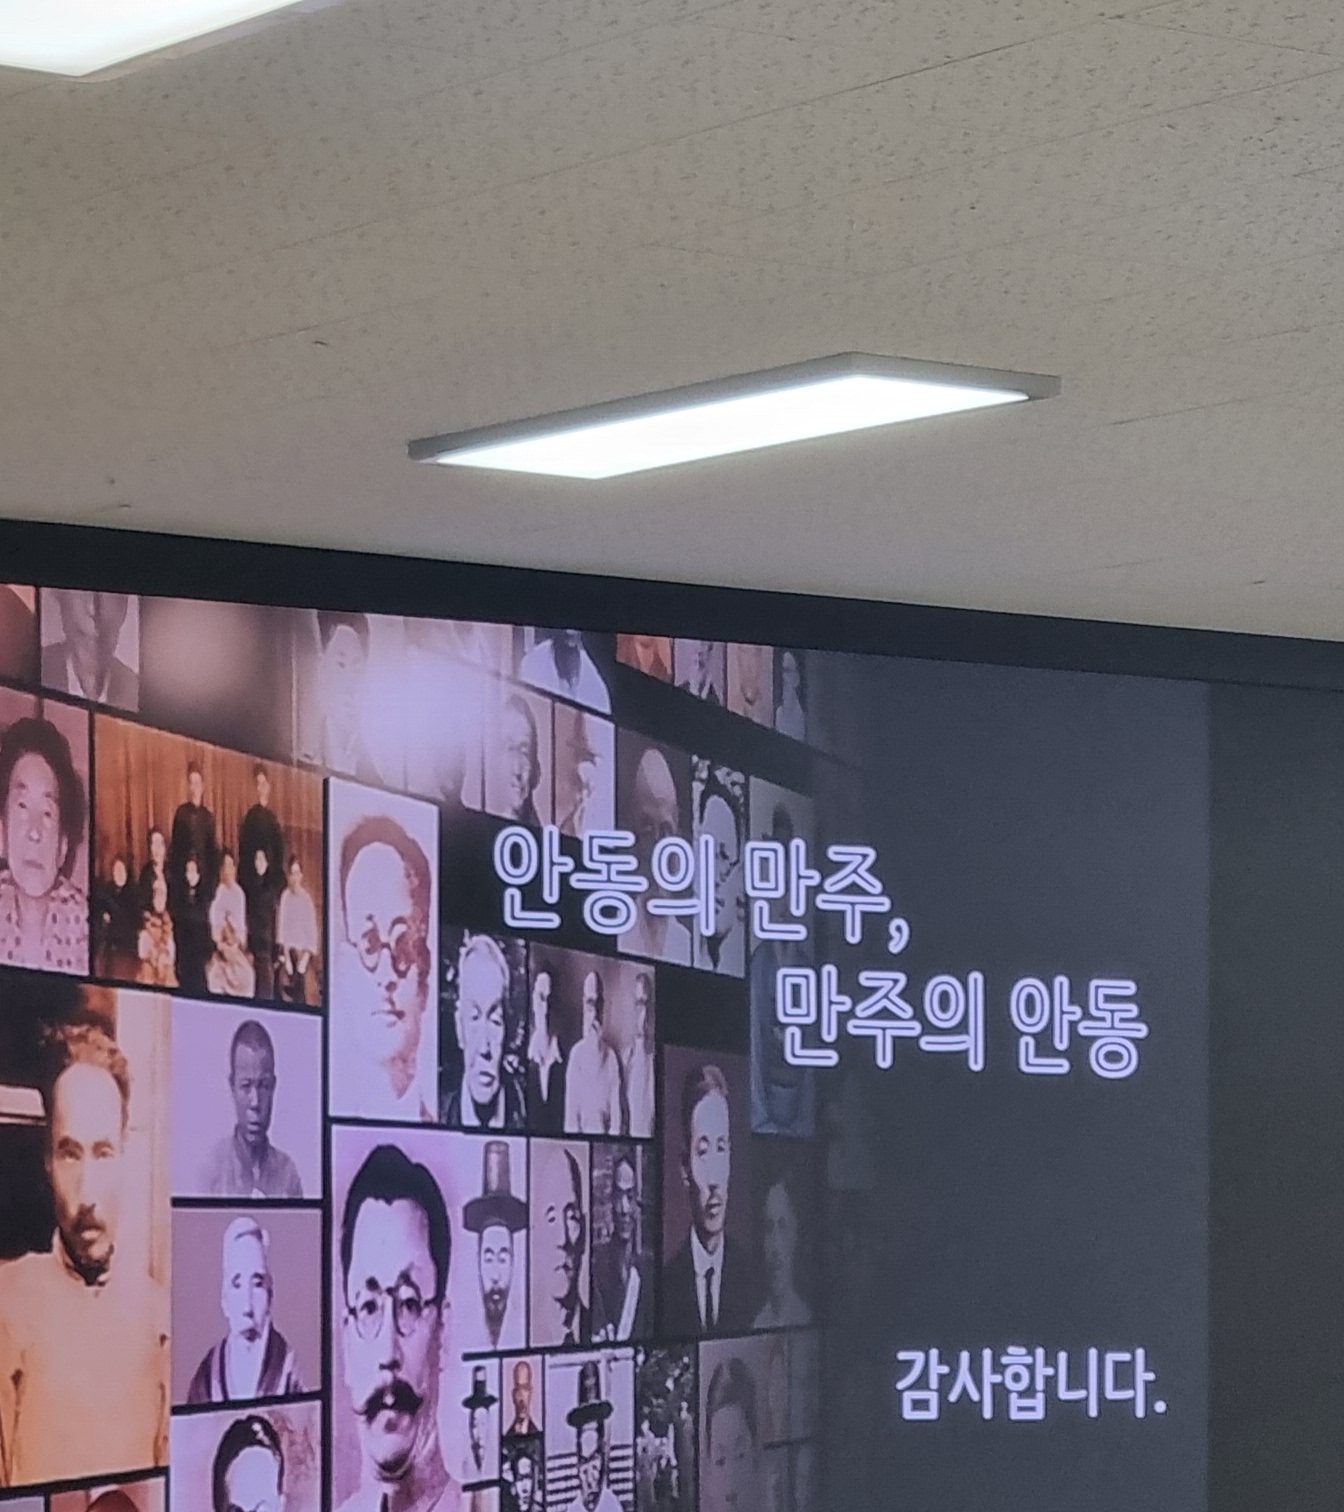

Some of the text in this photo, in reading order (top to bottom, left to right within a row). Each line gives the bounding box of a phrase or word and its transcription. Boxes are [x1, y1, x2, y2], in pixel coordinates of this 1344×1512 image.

[494, 824, 911, 953] 안동의 만주,
[776, 963, 1148, 1079] 만주의 안동
[896, 1346, 1167, 1420] 감사합니다.
